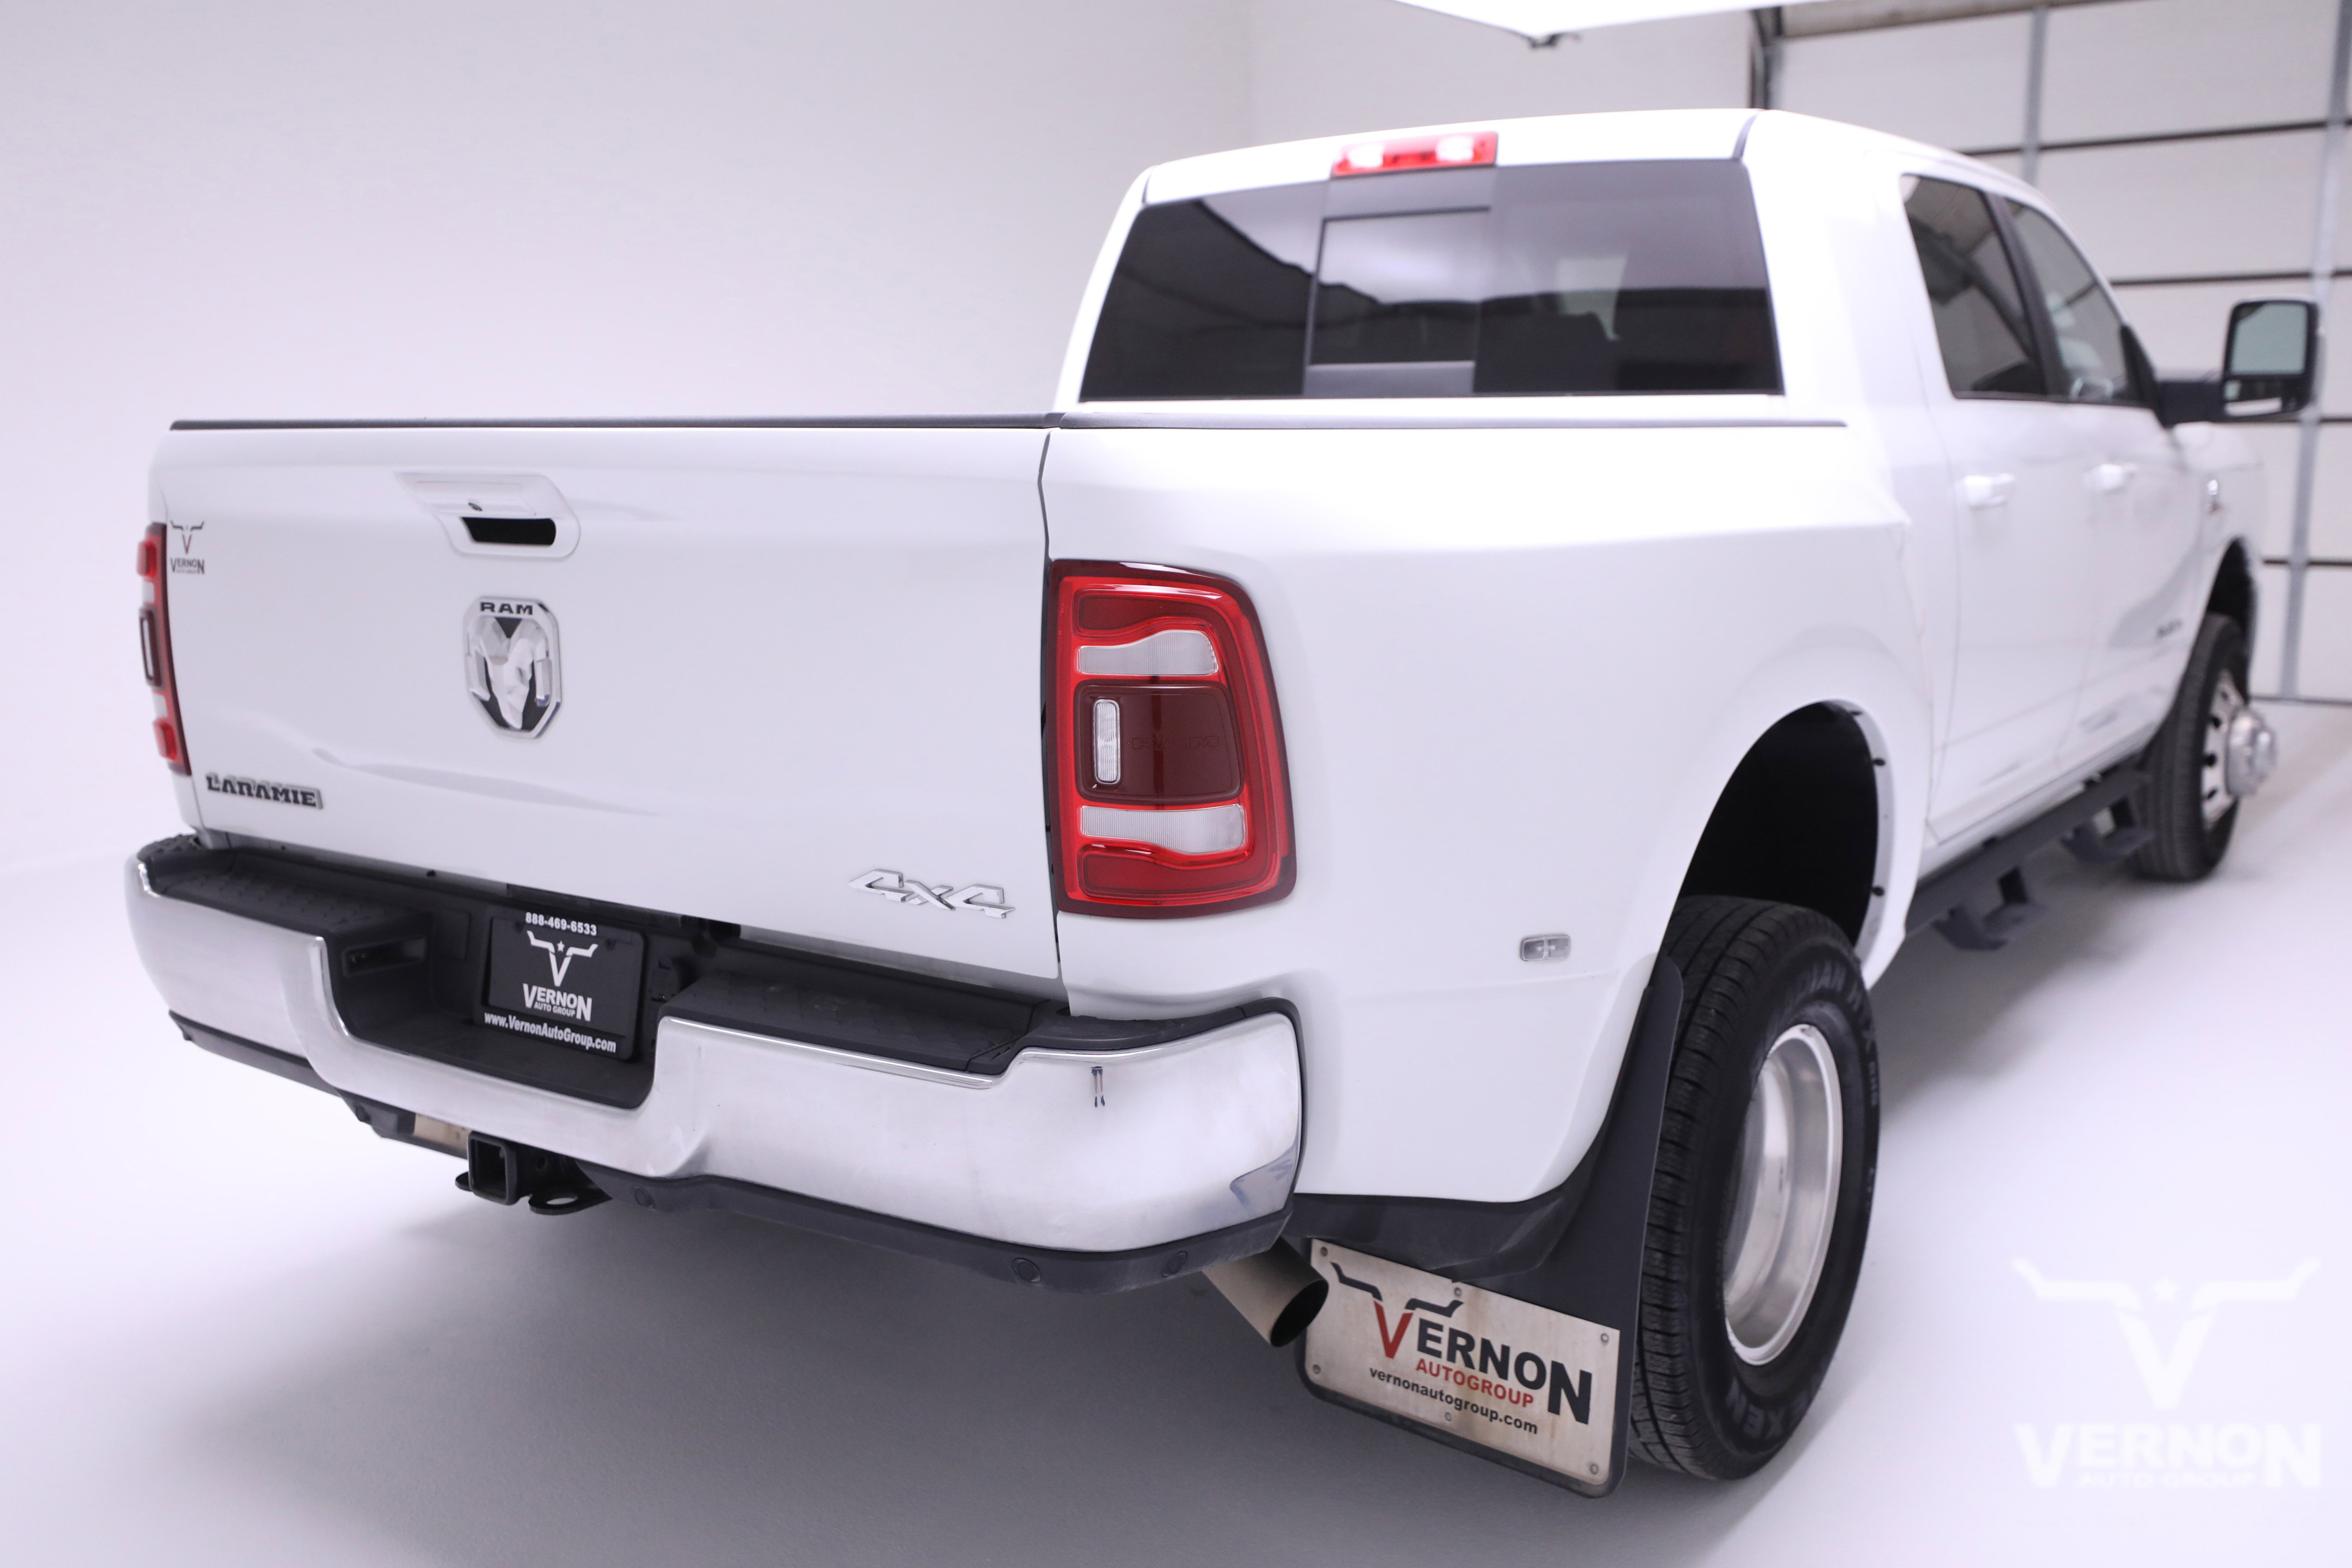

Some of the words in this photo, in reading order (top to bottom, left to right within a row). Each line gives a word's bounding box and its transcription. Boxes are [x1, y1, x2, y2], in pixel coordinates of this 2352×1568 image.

[170, 557, 205, 574] VERNON
[480, 602, 533, 615] RAM
[1132, 735, 1219, 750] RAM
[205, 774, 318, 808] LARAMIE
[525, 912, 597, 936] 888-469-6533
[523, 983, 592, 1022] VERNON
[534, 1002, 551, 1012] AUTO
[552, 1005, 576, 1017] GROUP
[484, 1012, 617, 1053] www.VernonAutoGroup.com
[1373, 1300, 1592, 1424] VERNON
[1416, 1358, 1534, 1408] AUTOGROUP
[1369, 1368, 1538, 1434] vernonautogroup.com
